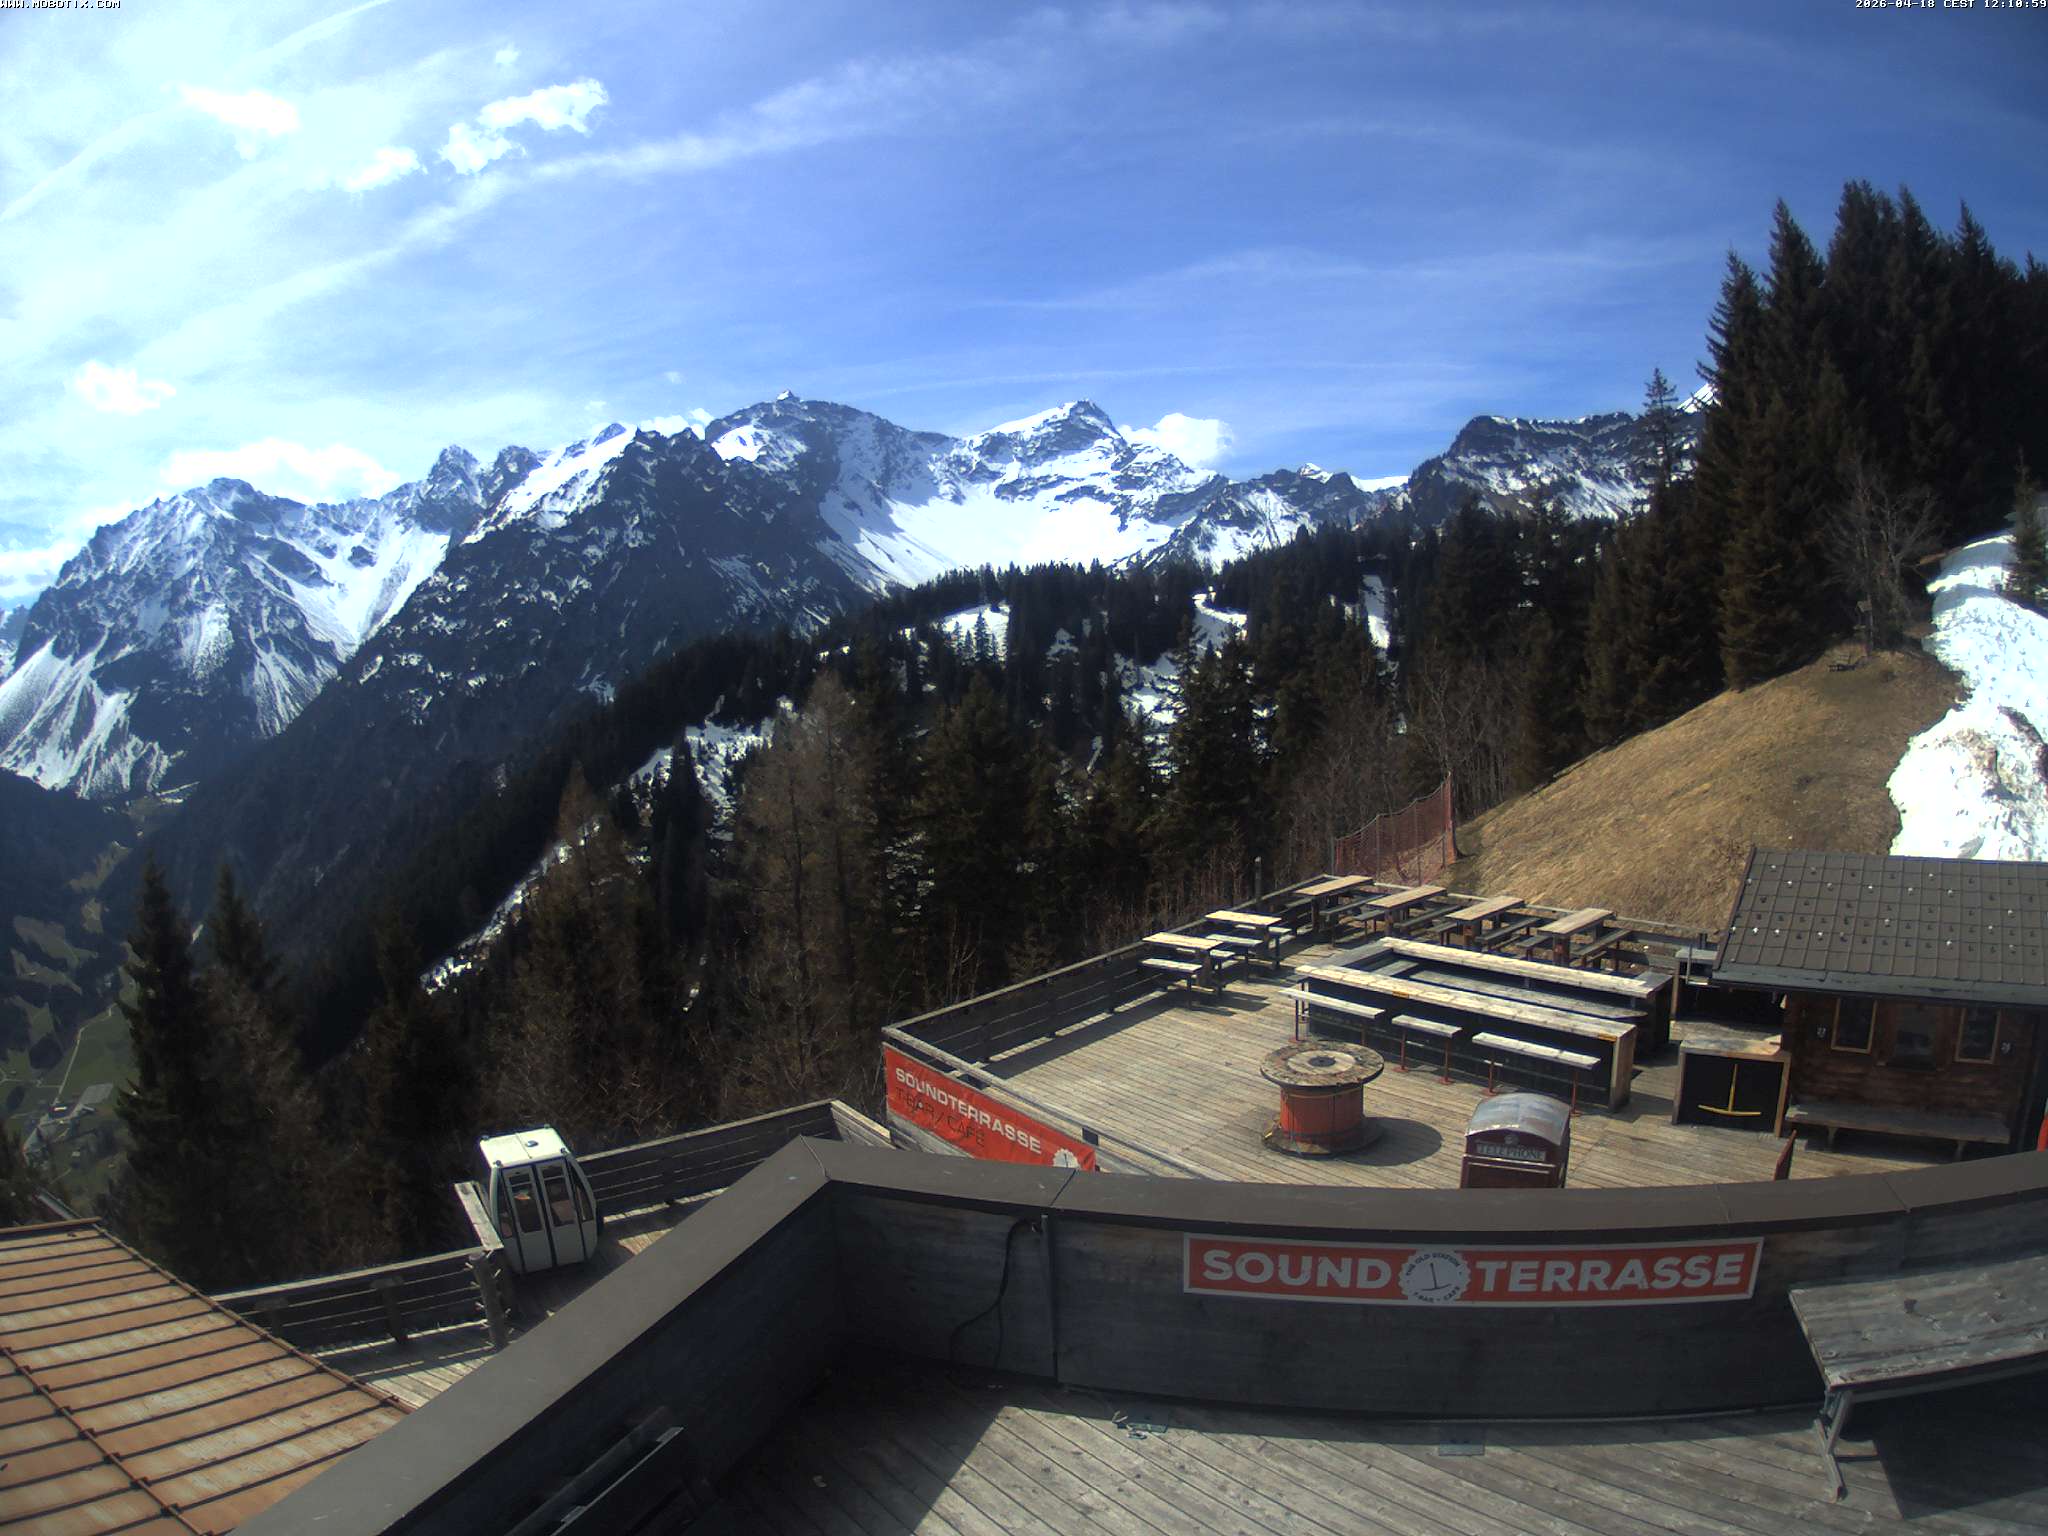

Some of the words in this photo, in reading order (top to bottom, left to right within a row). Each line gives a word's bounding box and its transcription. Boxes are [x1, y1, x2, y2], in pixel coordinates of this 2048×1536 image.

[895, 1067, 1042, 1154] SOUNDTERRASSE
[1477, 1142, 1545, 1161] TELEPHONE
[1203, 1249, 1392, 1289] SOUND
[1475, 1253, 1745, 1292] TERRASSE
